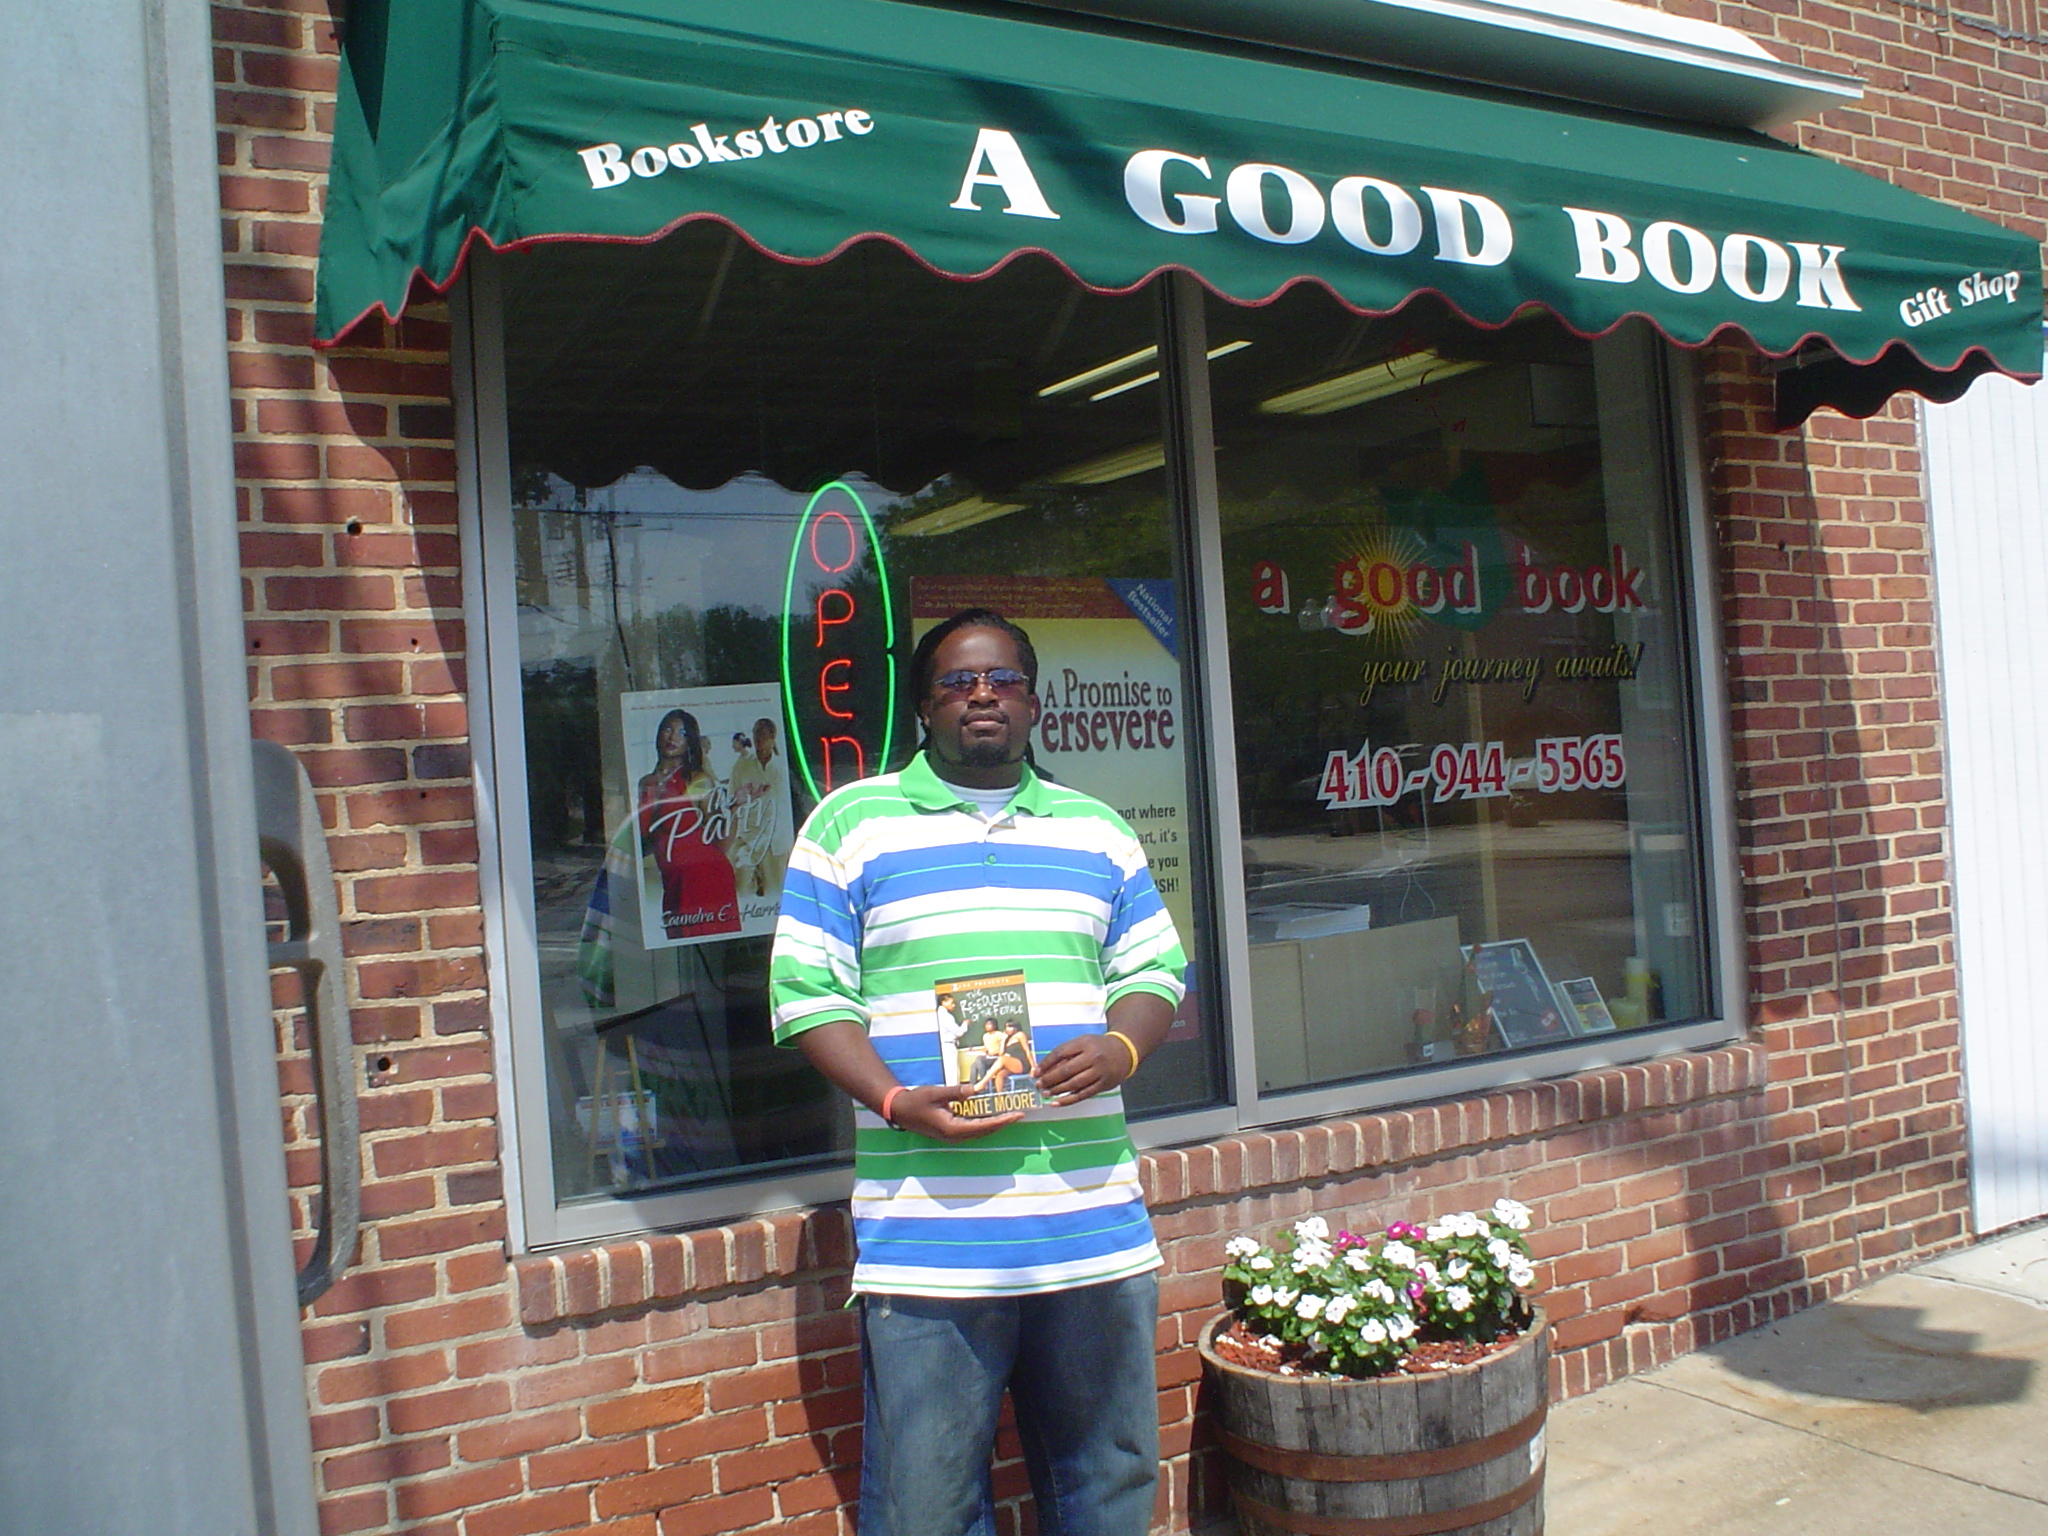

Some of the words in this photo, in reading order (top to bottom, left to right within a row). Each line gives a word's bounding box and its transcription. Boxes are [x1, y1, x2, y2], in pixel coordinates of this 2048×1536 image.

[577, 107, 875, 190] Bookstore
[949, 127, 1060, 220] A
[1123, 149, 1514, 268] GOOD
[1561, 206, 1862, 312] BOOK
[1899, 287, 1952, 328] Gift
[1958, 271, 2020, 308] Shop
[1136, 583, 1174, 625] National
[1252, 561, 1290, 614] a
[1333, 539, 1482, 636] good
[1518, 542, 1647, 614] book
[1128, 590, 1169, 638] Bestseller
[1044, 680, 1058, 708] A
[1062, 668, 1151, 708] Promise
[1157, 686, 1172, 706] to
[1359, 656, 1427, 706] your
[1432, 644, 1544, 704] journey
[1555, 640, 1646, 684] awaits!
[1317, 733, 1626, 810] 410-944-5565
[1139, 804, 1176, 819] where
[1160, 829, 1177, 843] it's
[1157, 857, 1178, 872] you
[953, 1097, 993, 1117] DANTE
[995, 1091, 1037, 1113] MOORE
